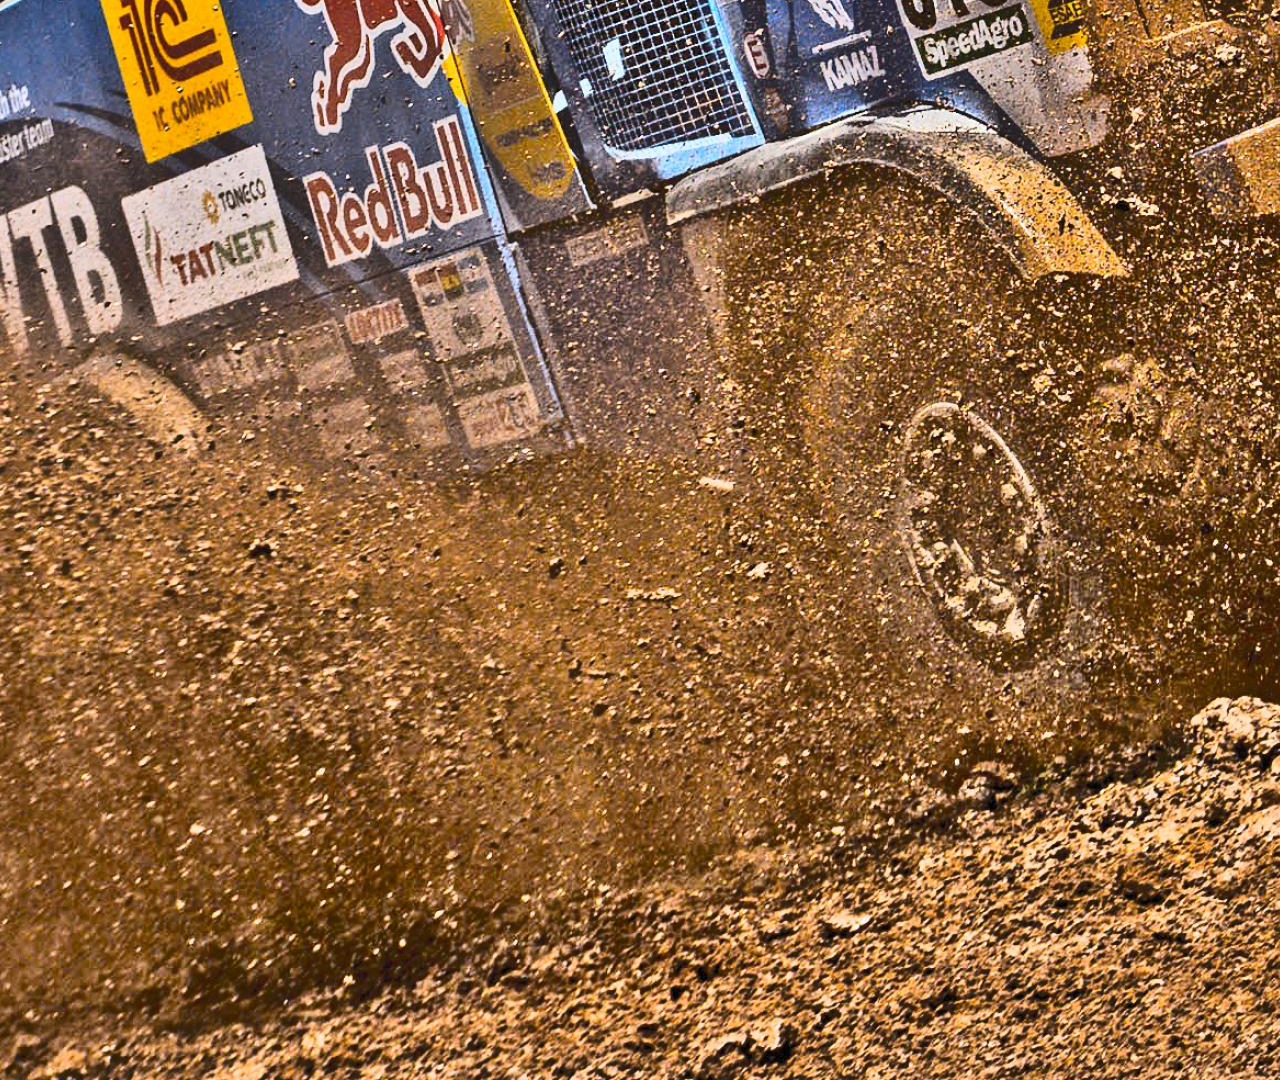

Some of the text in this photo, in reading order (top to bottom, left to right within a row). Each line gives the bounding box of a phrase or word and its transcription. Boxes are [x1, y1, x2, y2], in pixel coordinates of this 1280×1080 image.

[924, 15, 1025, 68] SpeedAgro
[820, 45, 886, 93] KAMAZ
[170, 78, 232, 125] COMPANY
[23, 117, 55, 150] team
[306, 116, 482, 264] Red Bull
[169, 219, 278, 287] TATNEFT
